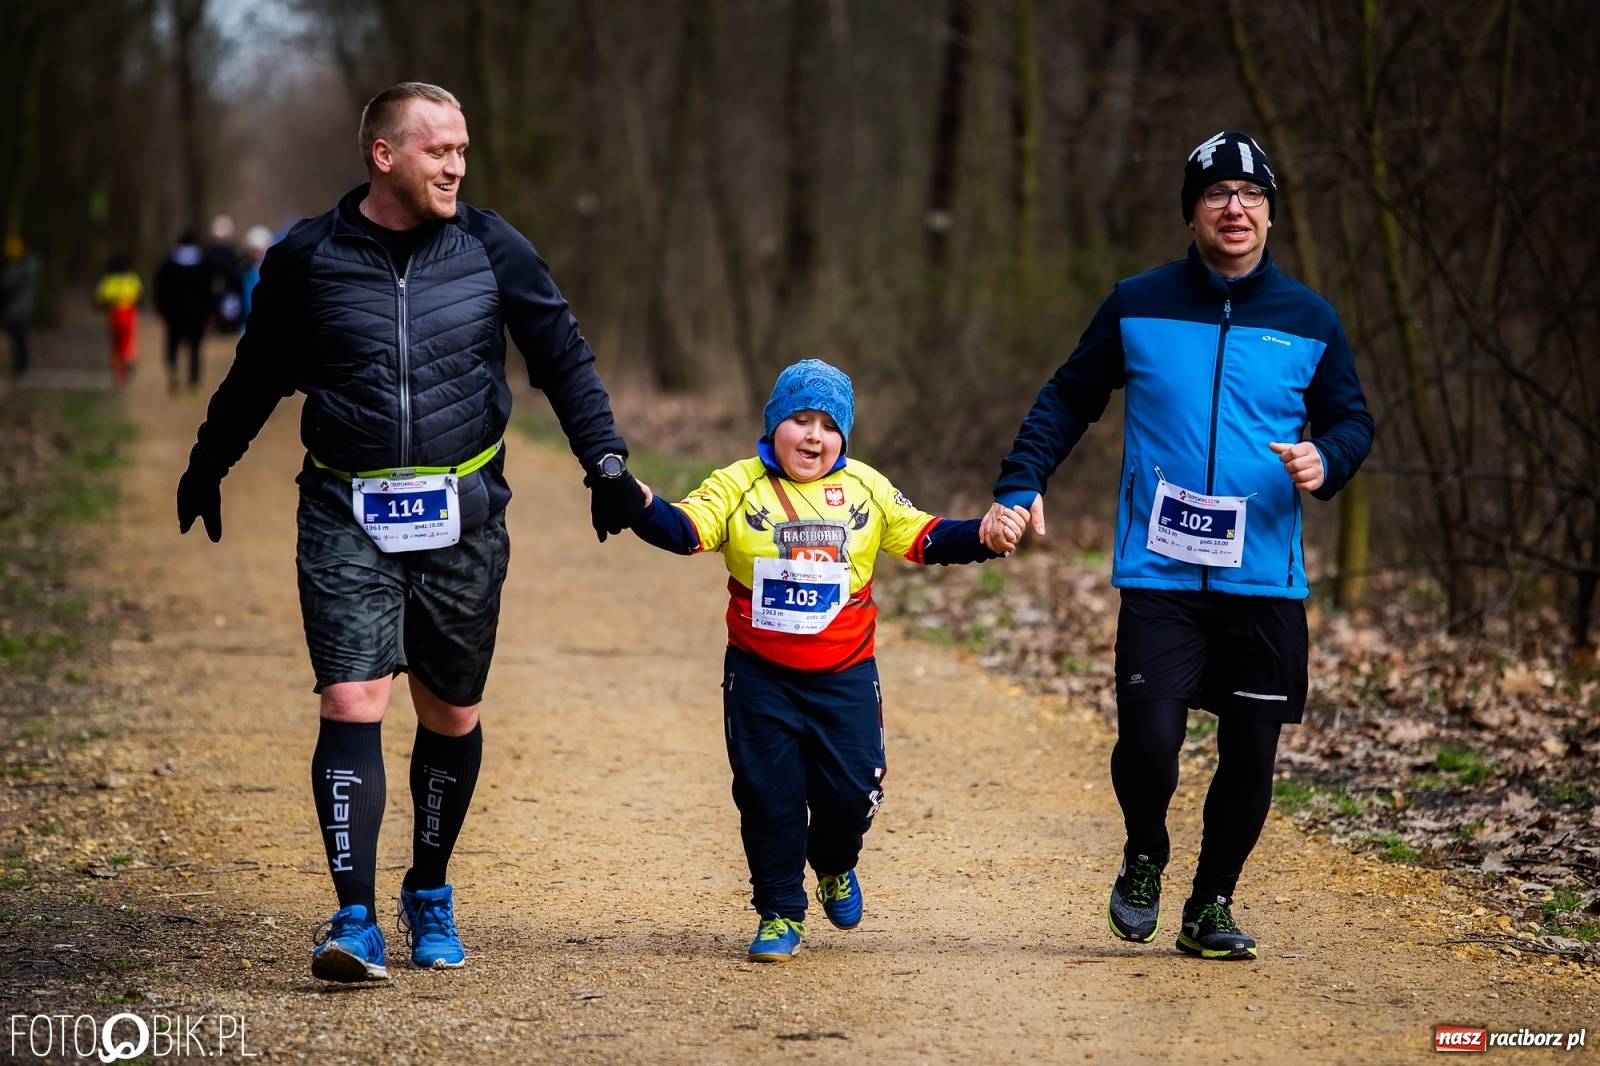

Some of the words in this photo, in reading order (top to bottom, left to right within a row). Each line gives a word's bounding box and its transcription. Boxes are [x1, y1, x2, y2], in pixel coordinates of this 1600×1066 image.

[388, 499, 425, 517] 114
[414, 522, 444, 530] godz.10.00
[1179, 510, 1213, 532] 102
[785, 587, 818, 606] 103
[762, 608, 777, 616] 1963
